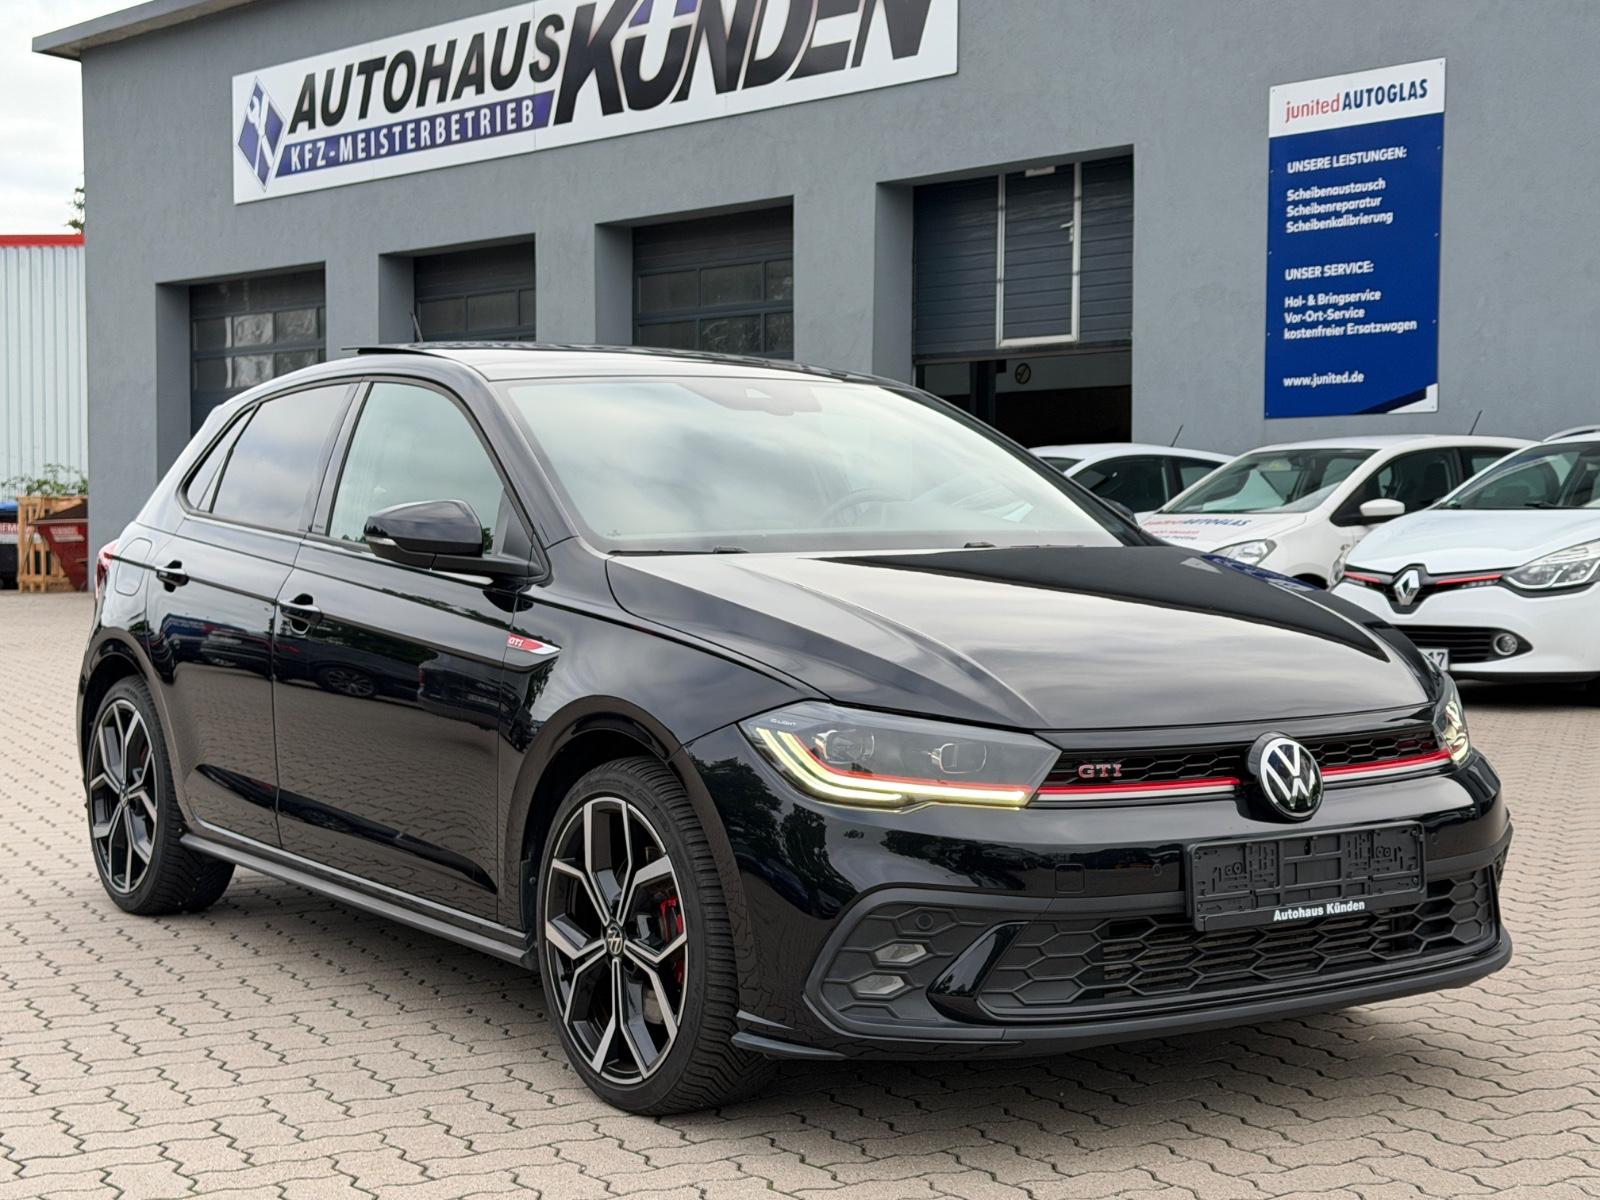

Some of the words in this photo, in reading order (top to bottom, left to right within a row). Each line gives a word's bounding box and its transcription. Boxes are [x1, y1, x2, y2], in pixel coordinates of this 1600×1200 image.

[287, 13, 566, 135] AUTOHAUS
[290, 98, 535, 172] KFZ-MEISTERBETRIEB
[1287, 156, 1331, 174] UNSERE
[1332, 146, 1408, 168] LEISTUNGEN:
[1286, 177, 1387, 202] Scheibenaustausch
[1286, 196, 1383, 218] Scheibenreparatur
[1285, 210, 1394, 234] Scheibenkalibrierung
[1285, 266, 1322, 281] UNSER
[1323, 260, 1375, 278] SERVICE:
[1284, 295, 1306, 308] Hol-
[1307, 293, 1317, 306] &
[1318, 288, 1382, 307] Bringservice
[1284, 306, 1365, 324] Vor-Ort-Service
[1284, 324, 1345, 340] kostenfreier
[1346, 319, 1418, 335] Ersatzwagen
[1283, 369, 1365, 387] www.junited.de
[1078, 763, 1123, 779] GTI
[1273, 906, 1324, 922] Autohaus
[1326, 900, 1365, 915] Künden
